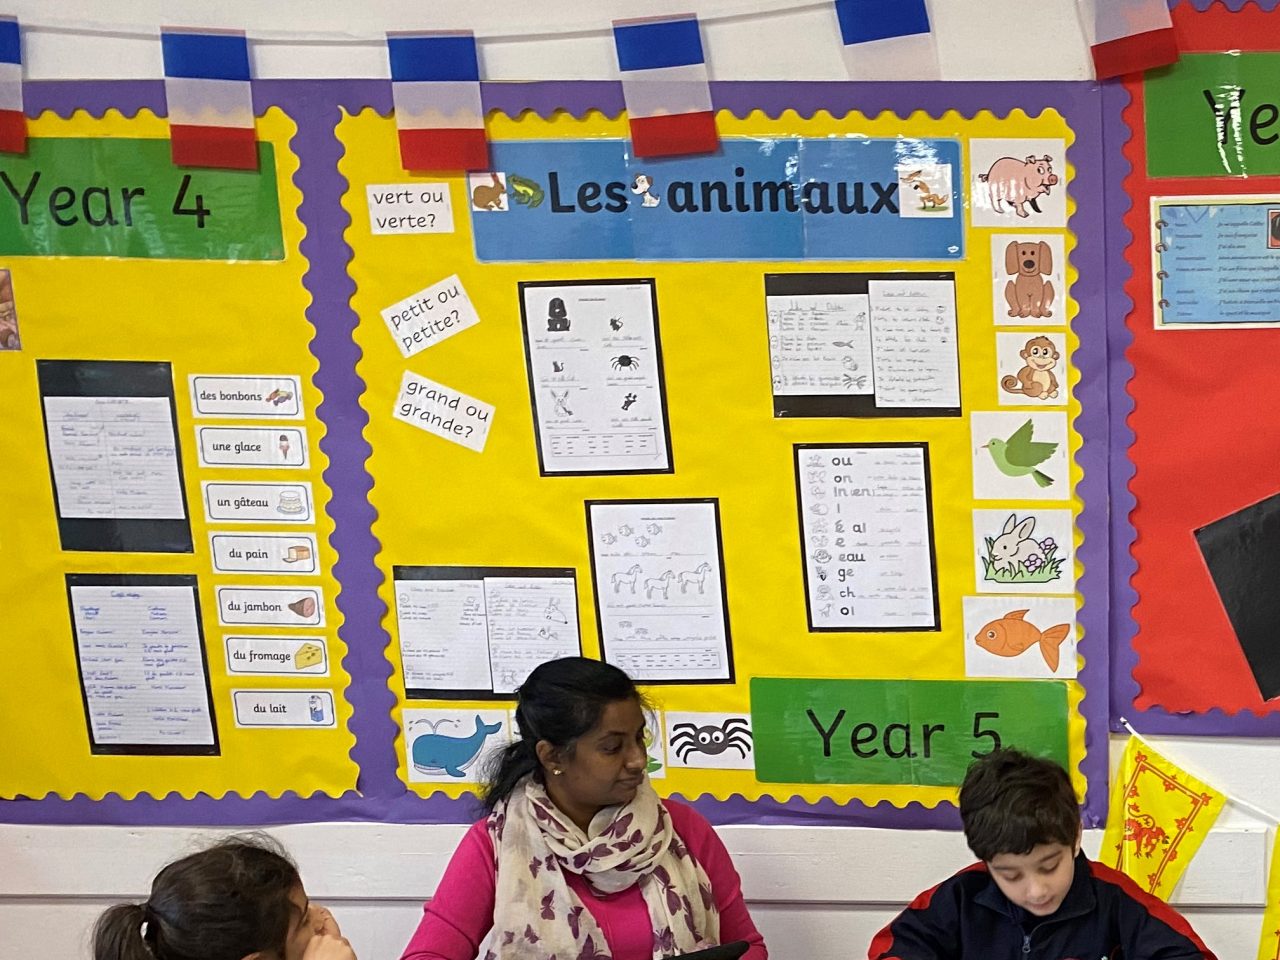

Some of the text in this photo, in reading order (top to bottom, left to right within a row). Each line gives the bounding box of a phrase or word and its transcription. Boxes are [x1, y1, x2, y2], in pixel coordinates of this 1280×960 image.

[0, 170, 212, 229] Year 4
[373, 189, 444, 205] vert ou
[548, 167, 900, 216] Les animaux
[376, 212, 437, 230] verte?
[390, 283, 461, 330] petit ou
[401, 309, 462, 352] petite?
[199, 389, 263, 402] des bonbons
[406, 378, 489, 423] grand ou
[399, 400, 475, 439] grande?
[212, 440, 262, 456] une glace
[831, 457, 853, 466] ou
[834, 475, 853, 483] on
[216, 496, 269, 512] un gâteau
[229, 547, 269, 561] du pain
[838, 552, 866, 562] eau
[837, 568, 855, 583] ge
[839, 585, 857, 598] ch
[227, 600, 283, 615] du jambon
[233, 649, 292, 665] du fromage
[253, 701, 288, 714] du lait
[804, 708, 1002, 760] Year 5
